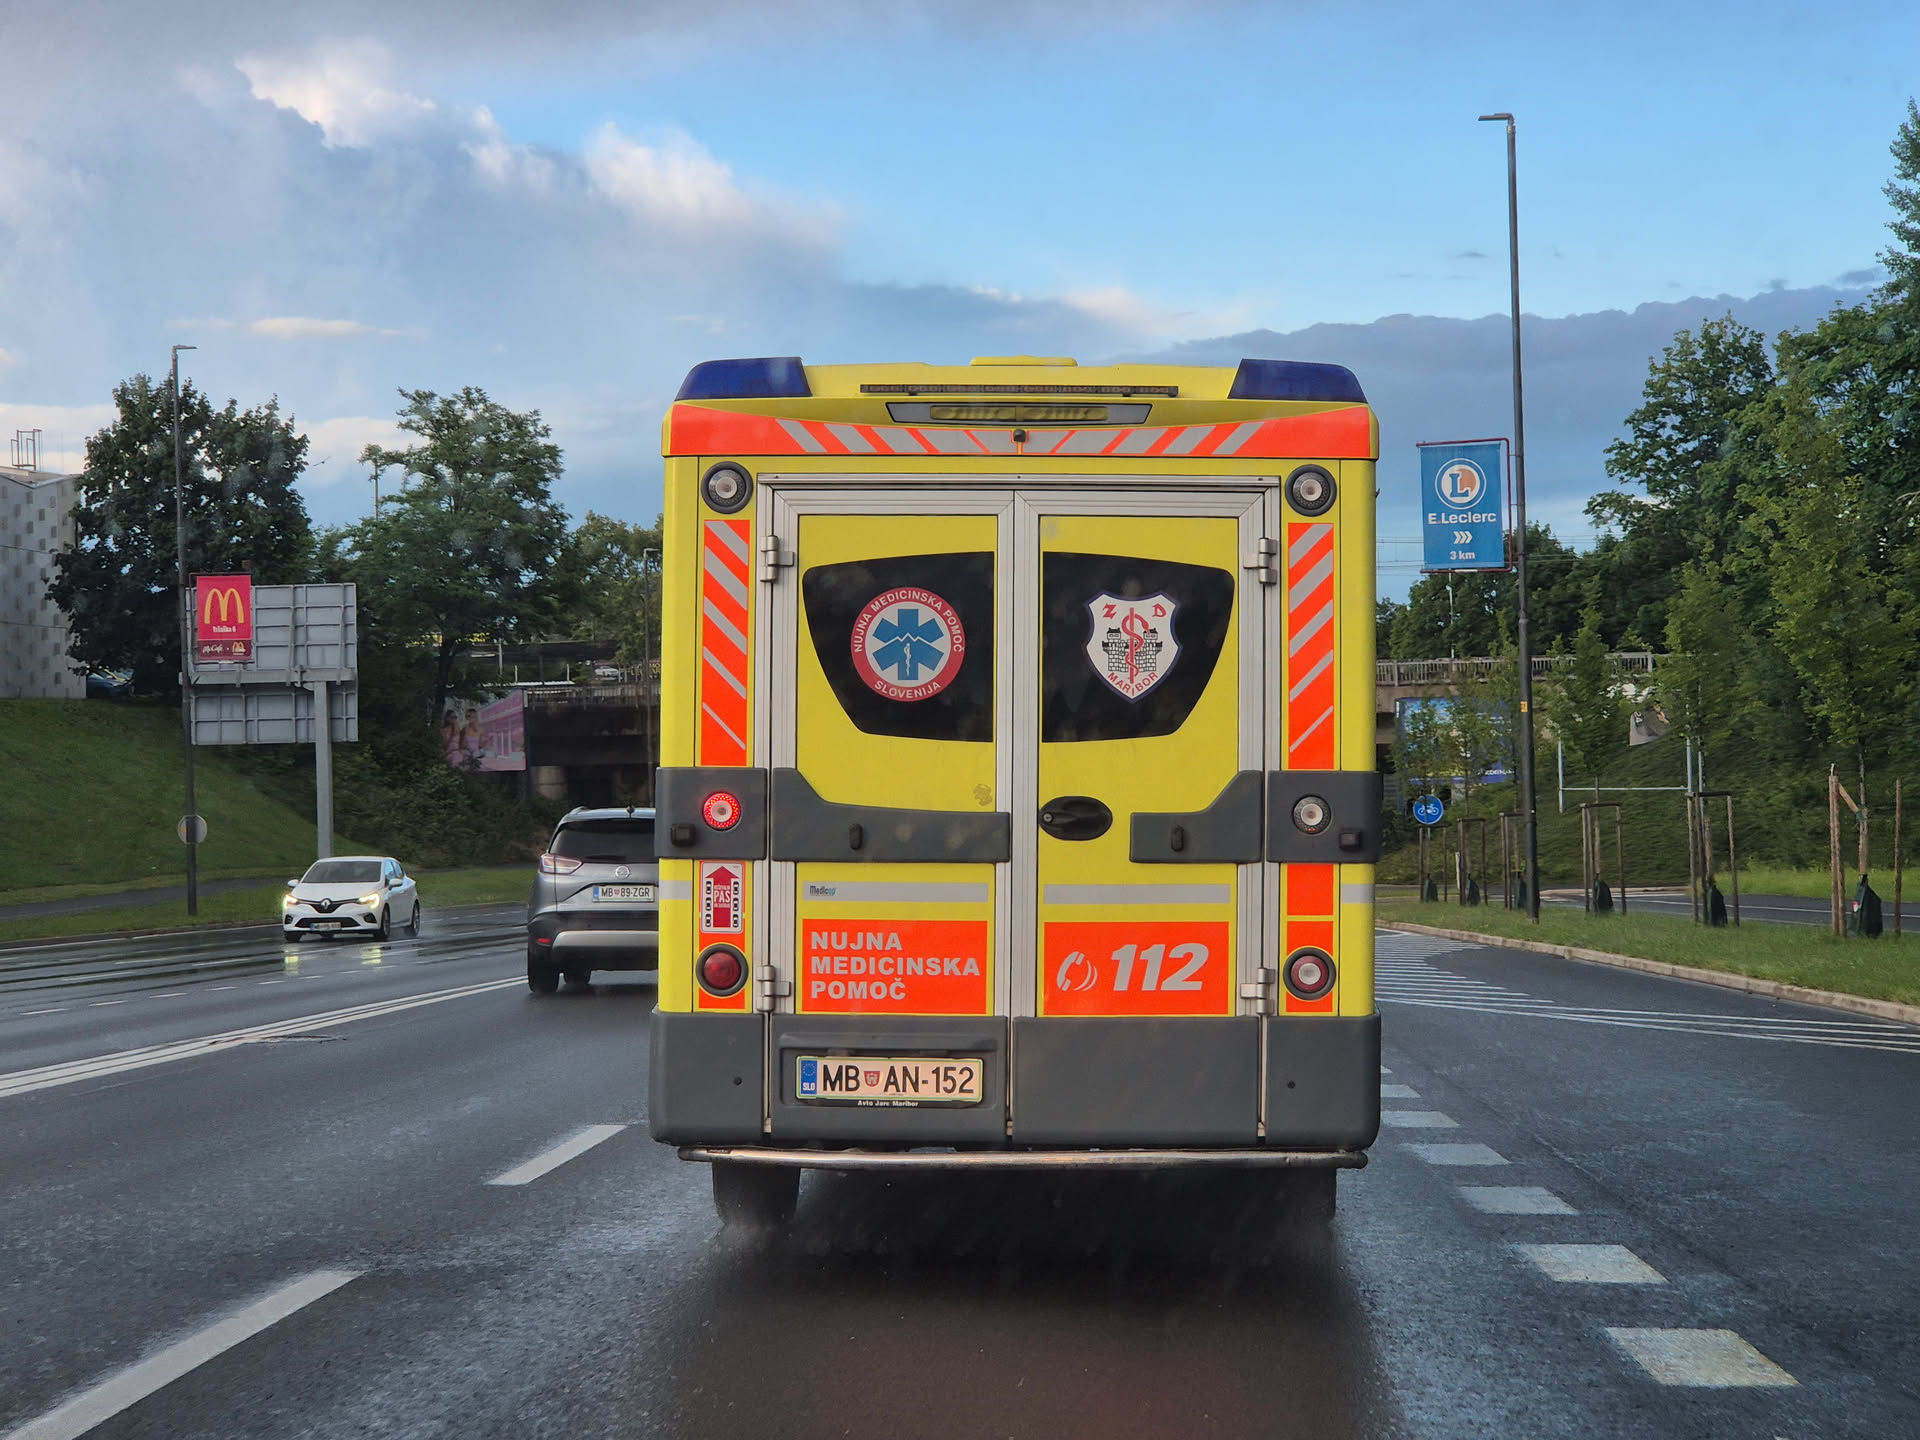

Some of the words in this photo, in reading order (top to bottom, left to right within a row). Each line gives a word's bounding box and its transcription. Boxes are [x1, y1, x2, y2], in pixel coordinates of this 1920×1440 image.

[1428, 512, 1497, 524] E.Leclerc
[1450, 551, 1457, 560] 3
[1458, 551, 1475, 560] km
[1102, 603, 1117, 619] Z
[1152, 603, 1167, 618] D
[854, 613, 872, 652] NUJNA
[870, 590, 943, 612] MEDICINSKA
[943, 609, 965, 653] POMOČ
[874, 681, 941, 698] SLOVENIJA
[1107, 672, 1158, 696] MARIBOR
[601, 887, 614, 897] MB
[620, 887, 650, 897] 89-ZGR
[714, 890, 731, 903] PAS
[811, 931, 903, 951] NUJNA
[811, 956, 980, 976] MEDICINSKA
[1111, 943, 1209, 992] 112
[811, 977, 906, 1000] POMOČ
[802, 1082, 816, 1091] SLO
[822, 1064, 860, 1092] MB
[883, 1065, 974, 1094] AN-152
[892, 1100, 919, 1108] Maribor
